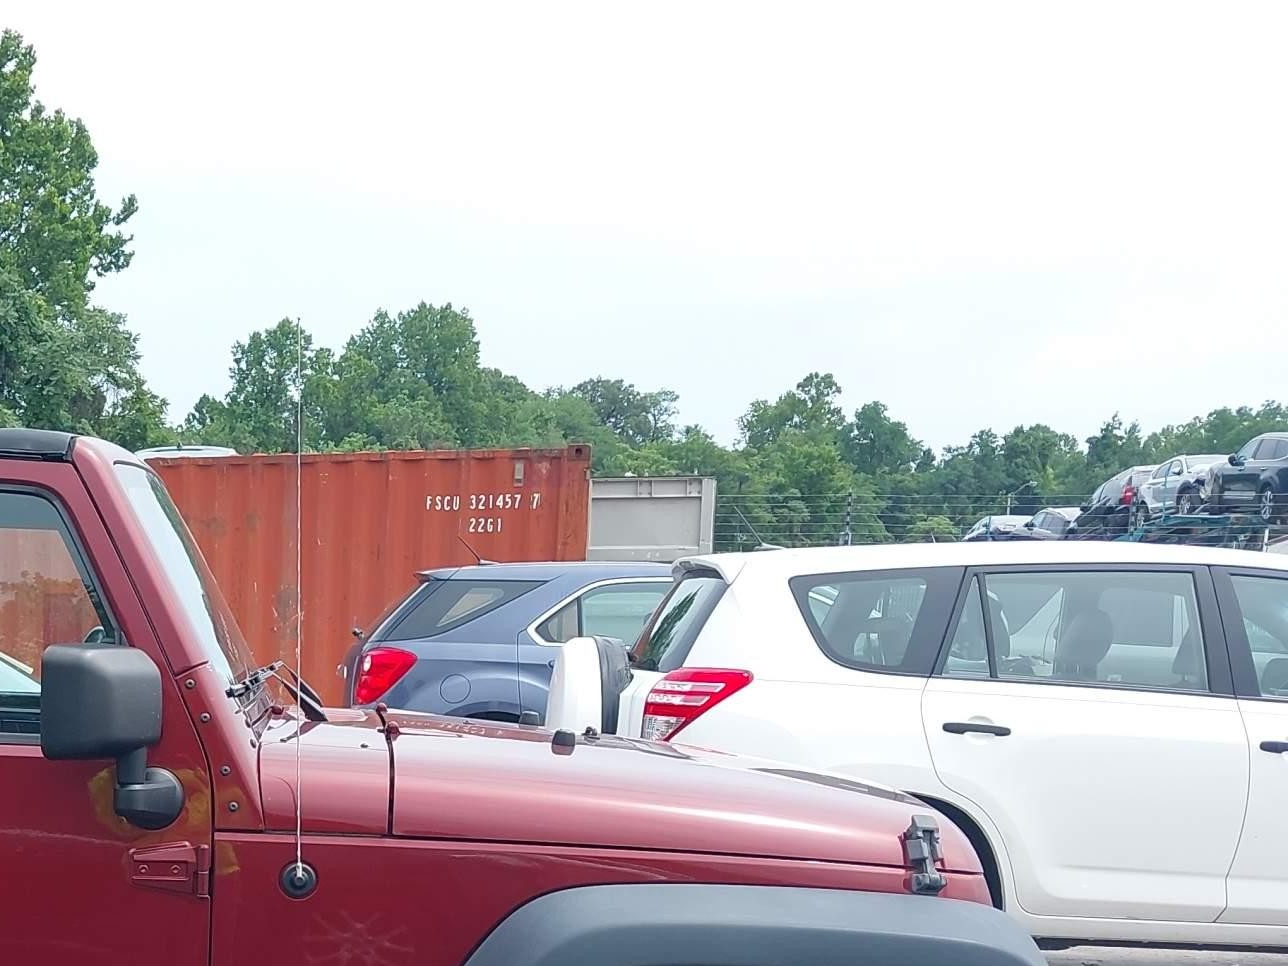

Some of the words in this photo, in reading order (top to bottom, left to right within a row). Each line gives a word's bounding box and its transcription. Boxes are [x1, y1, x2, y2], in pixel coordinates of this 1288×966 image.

[425, 495, 460, 511] FSCU
[470, 493, 522, 510] 321457
[531, 493, 541, 510] 7
[469, 517, 503, 533] 22G1
